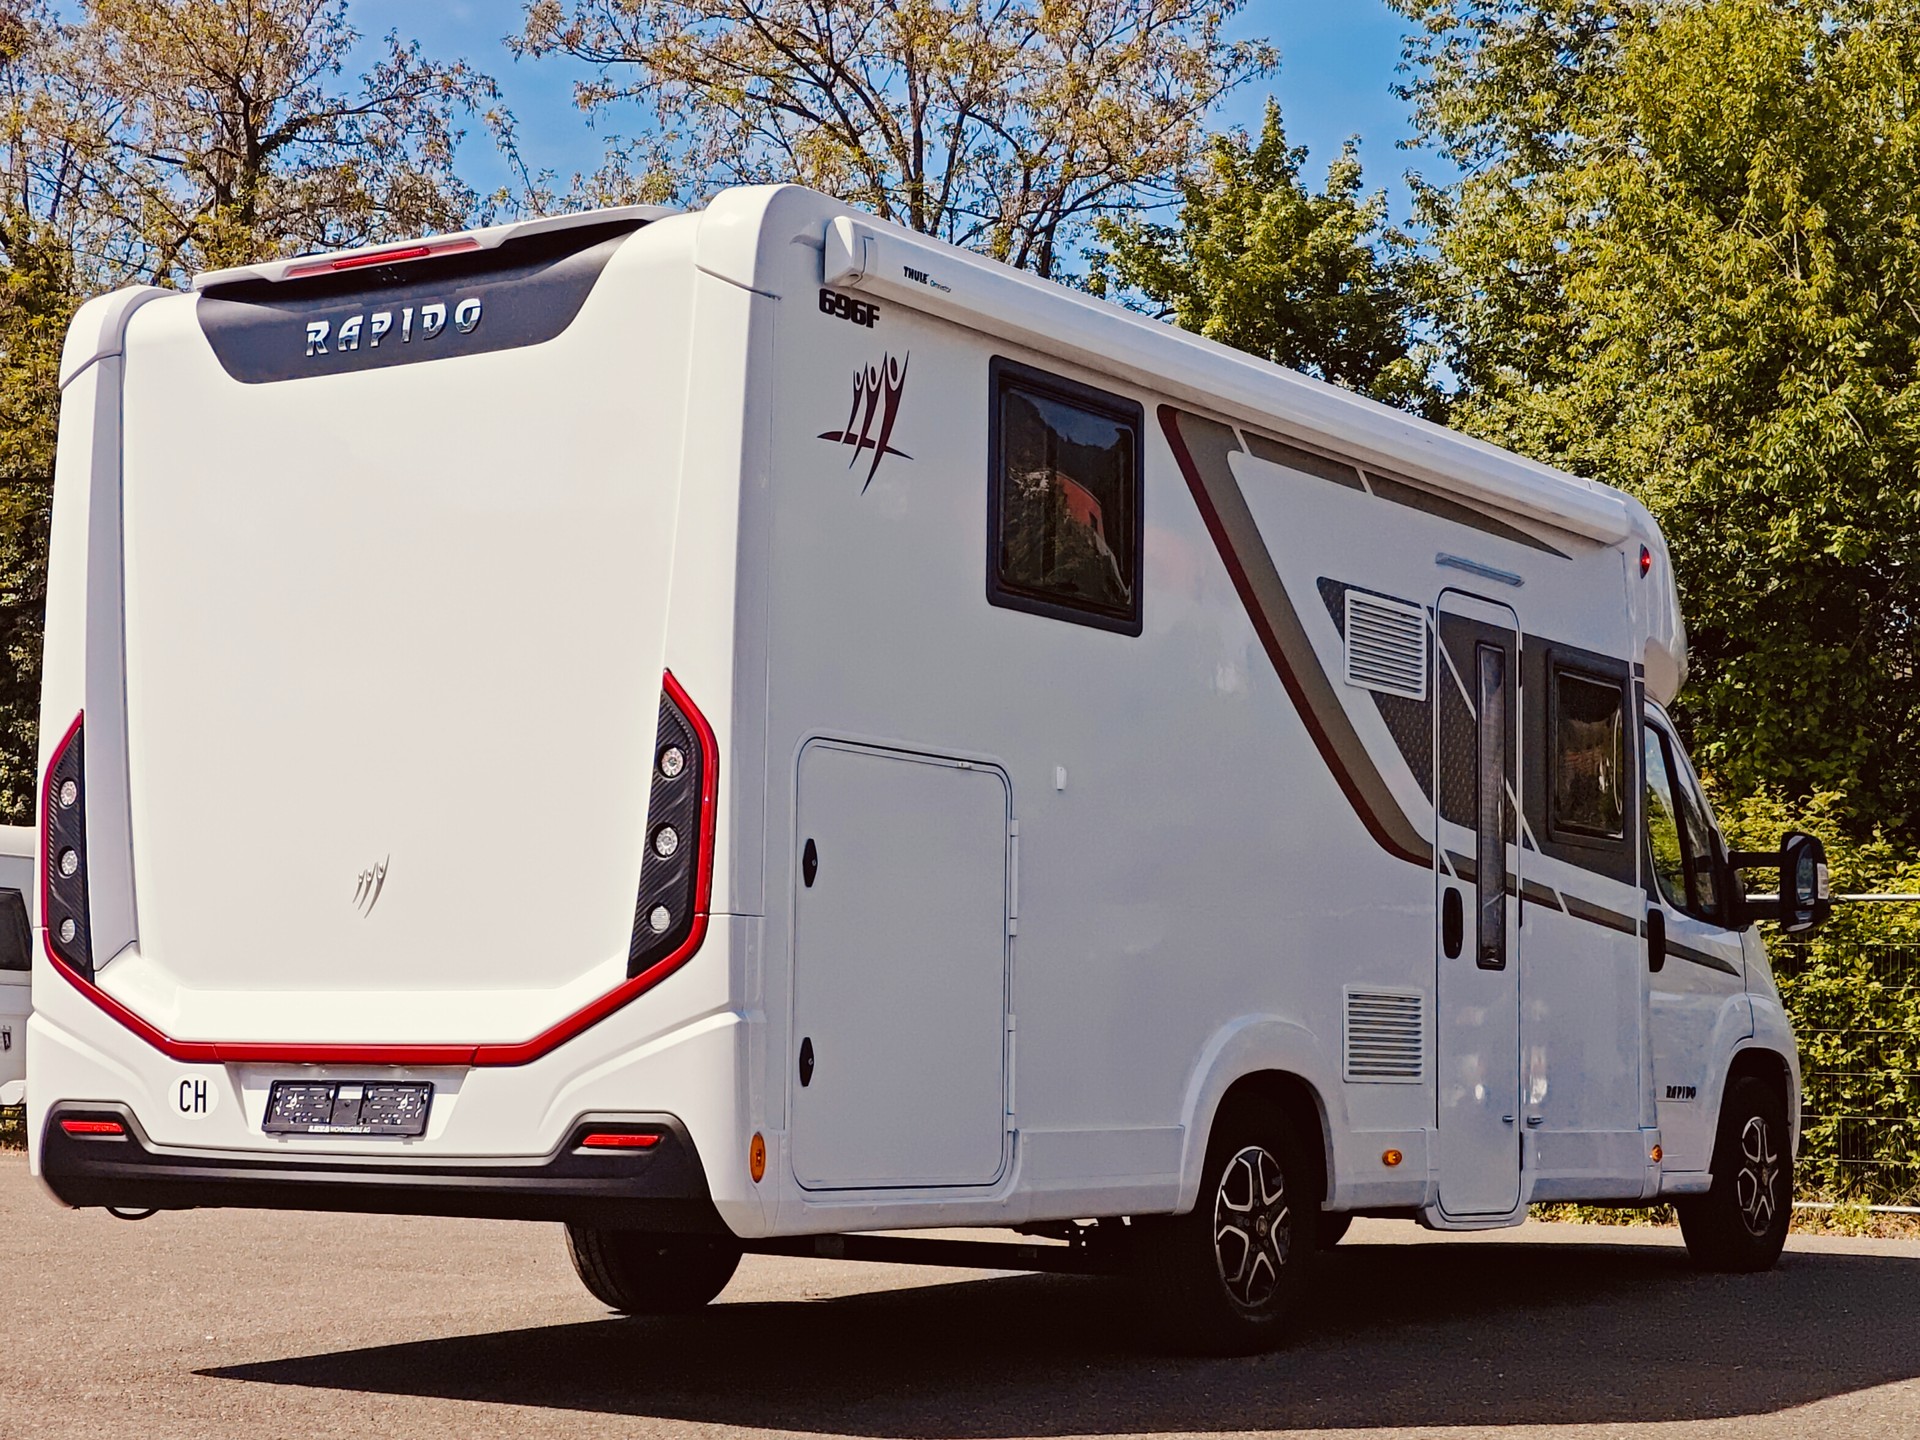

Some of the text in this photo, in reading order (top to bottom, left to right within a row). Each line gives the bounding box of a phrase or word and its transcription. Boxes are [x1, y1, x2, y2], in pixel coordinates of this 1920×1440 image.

[903, 265, 930, 285] THULE
[819, 288, 880, 328] 696F
[305, 297, 482, 357] RAPIDO
[179, 1079, 207, 1113] CH
[1665, 1085, 1697, 1100] RAPIDO
